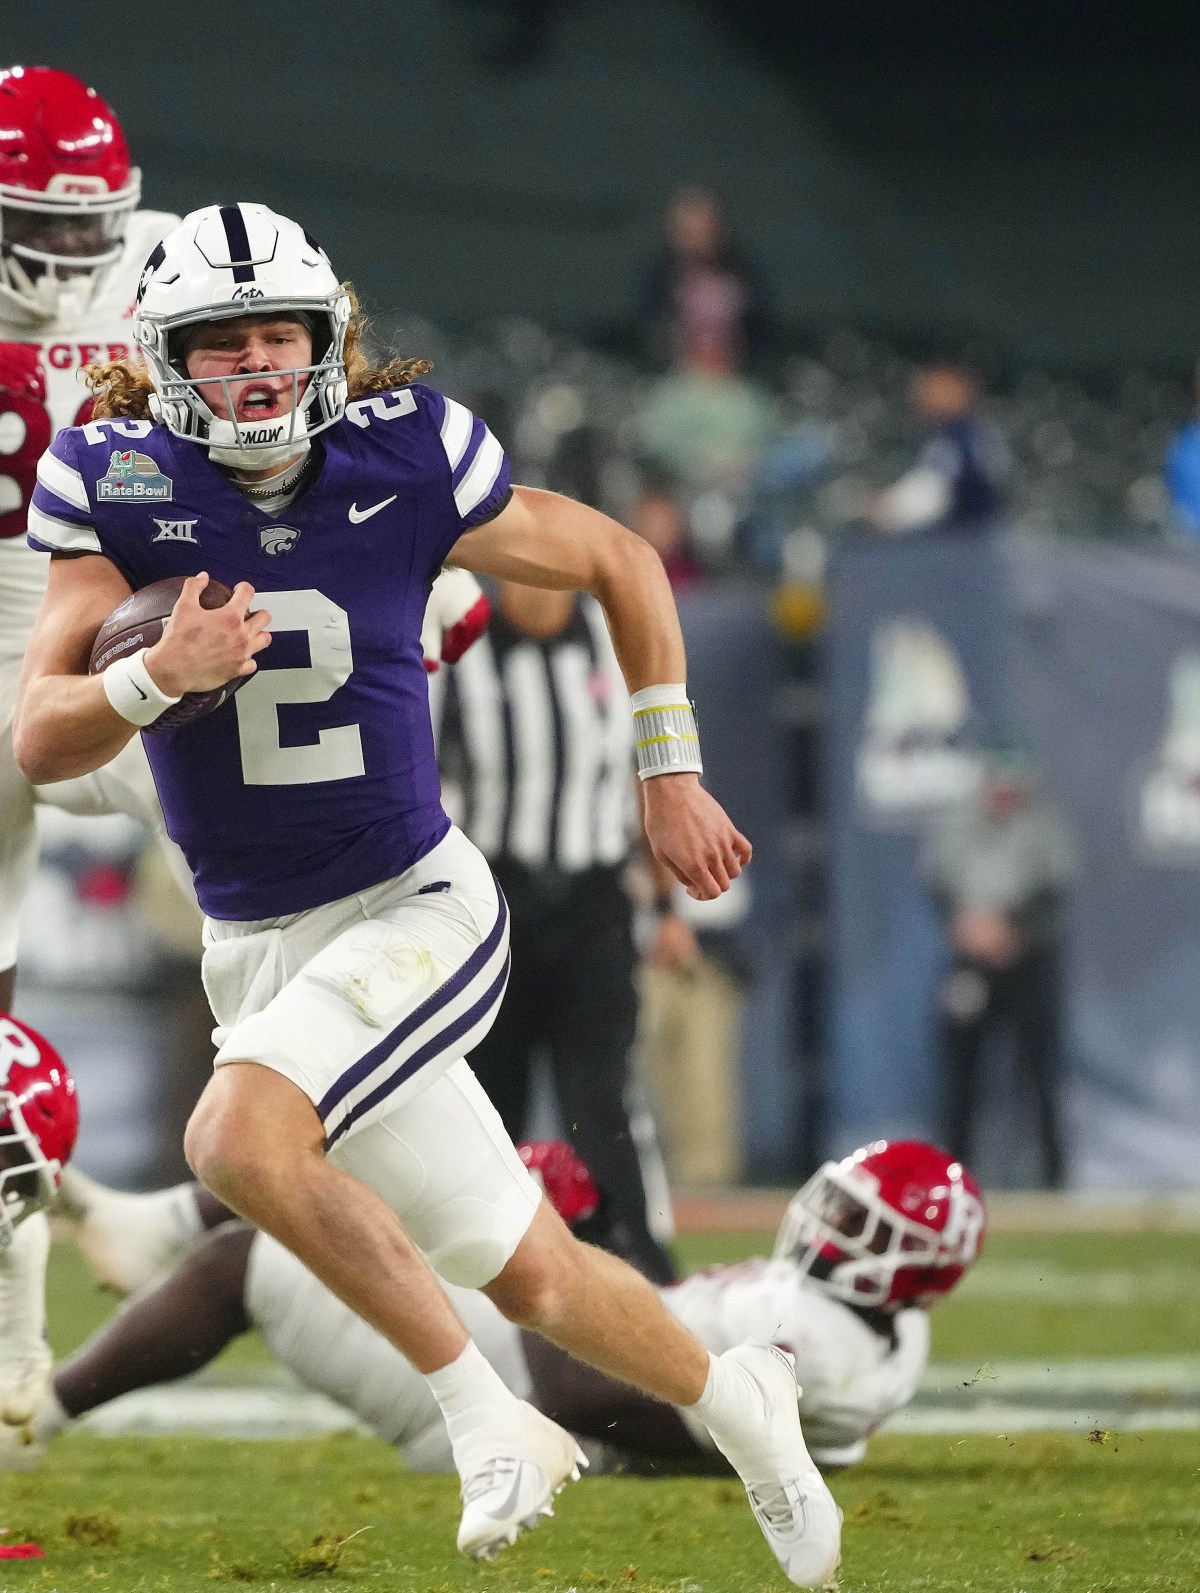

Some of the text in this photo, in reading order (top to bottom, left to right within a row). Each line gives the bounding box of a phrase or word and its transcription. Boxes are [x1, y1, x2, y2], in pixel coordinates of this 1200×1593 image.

[345, 388, 418, 429] 2
[152, 518, 199, 544] XII
[234, 588, 366, 785] 2
